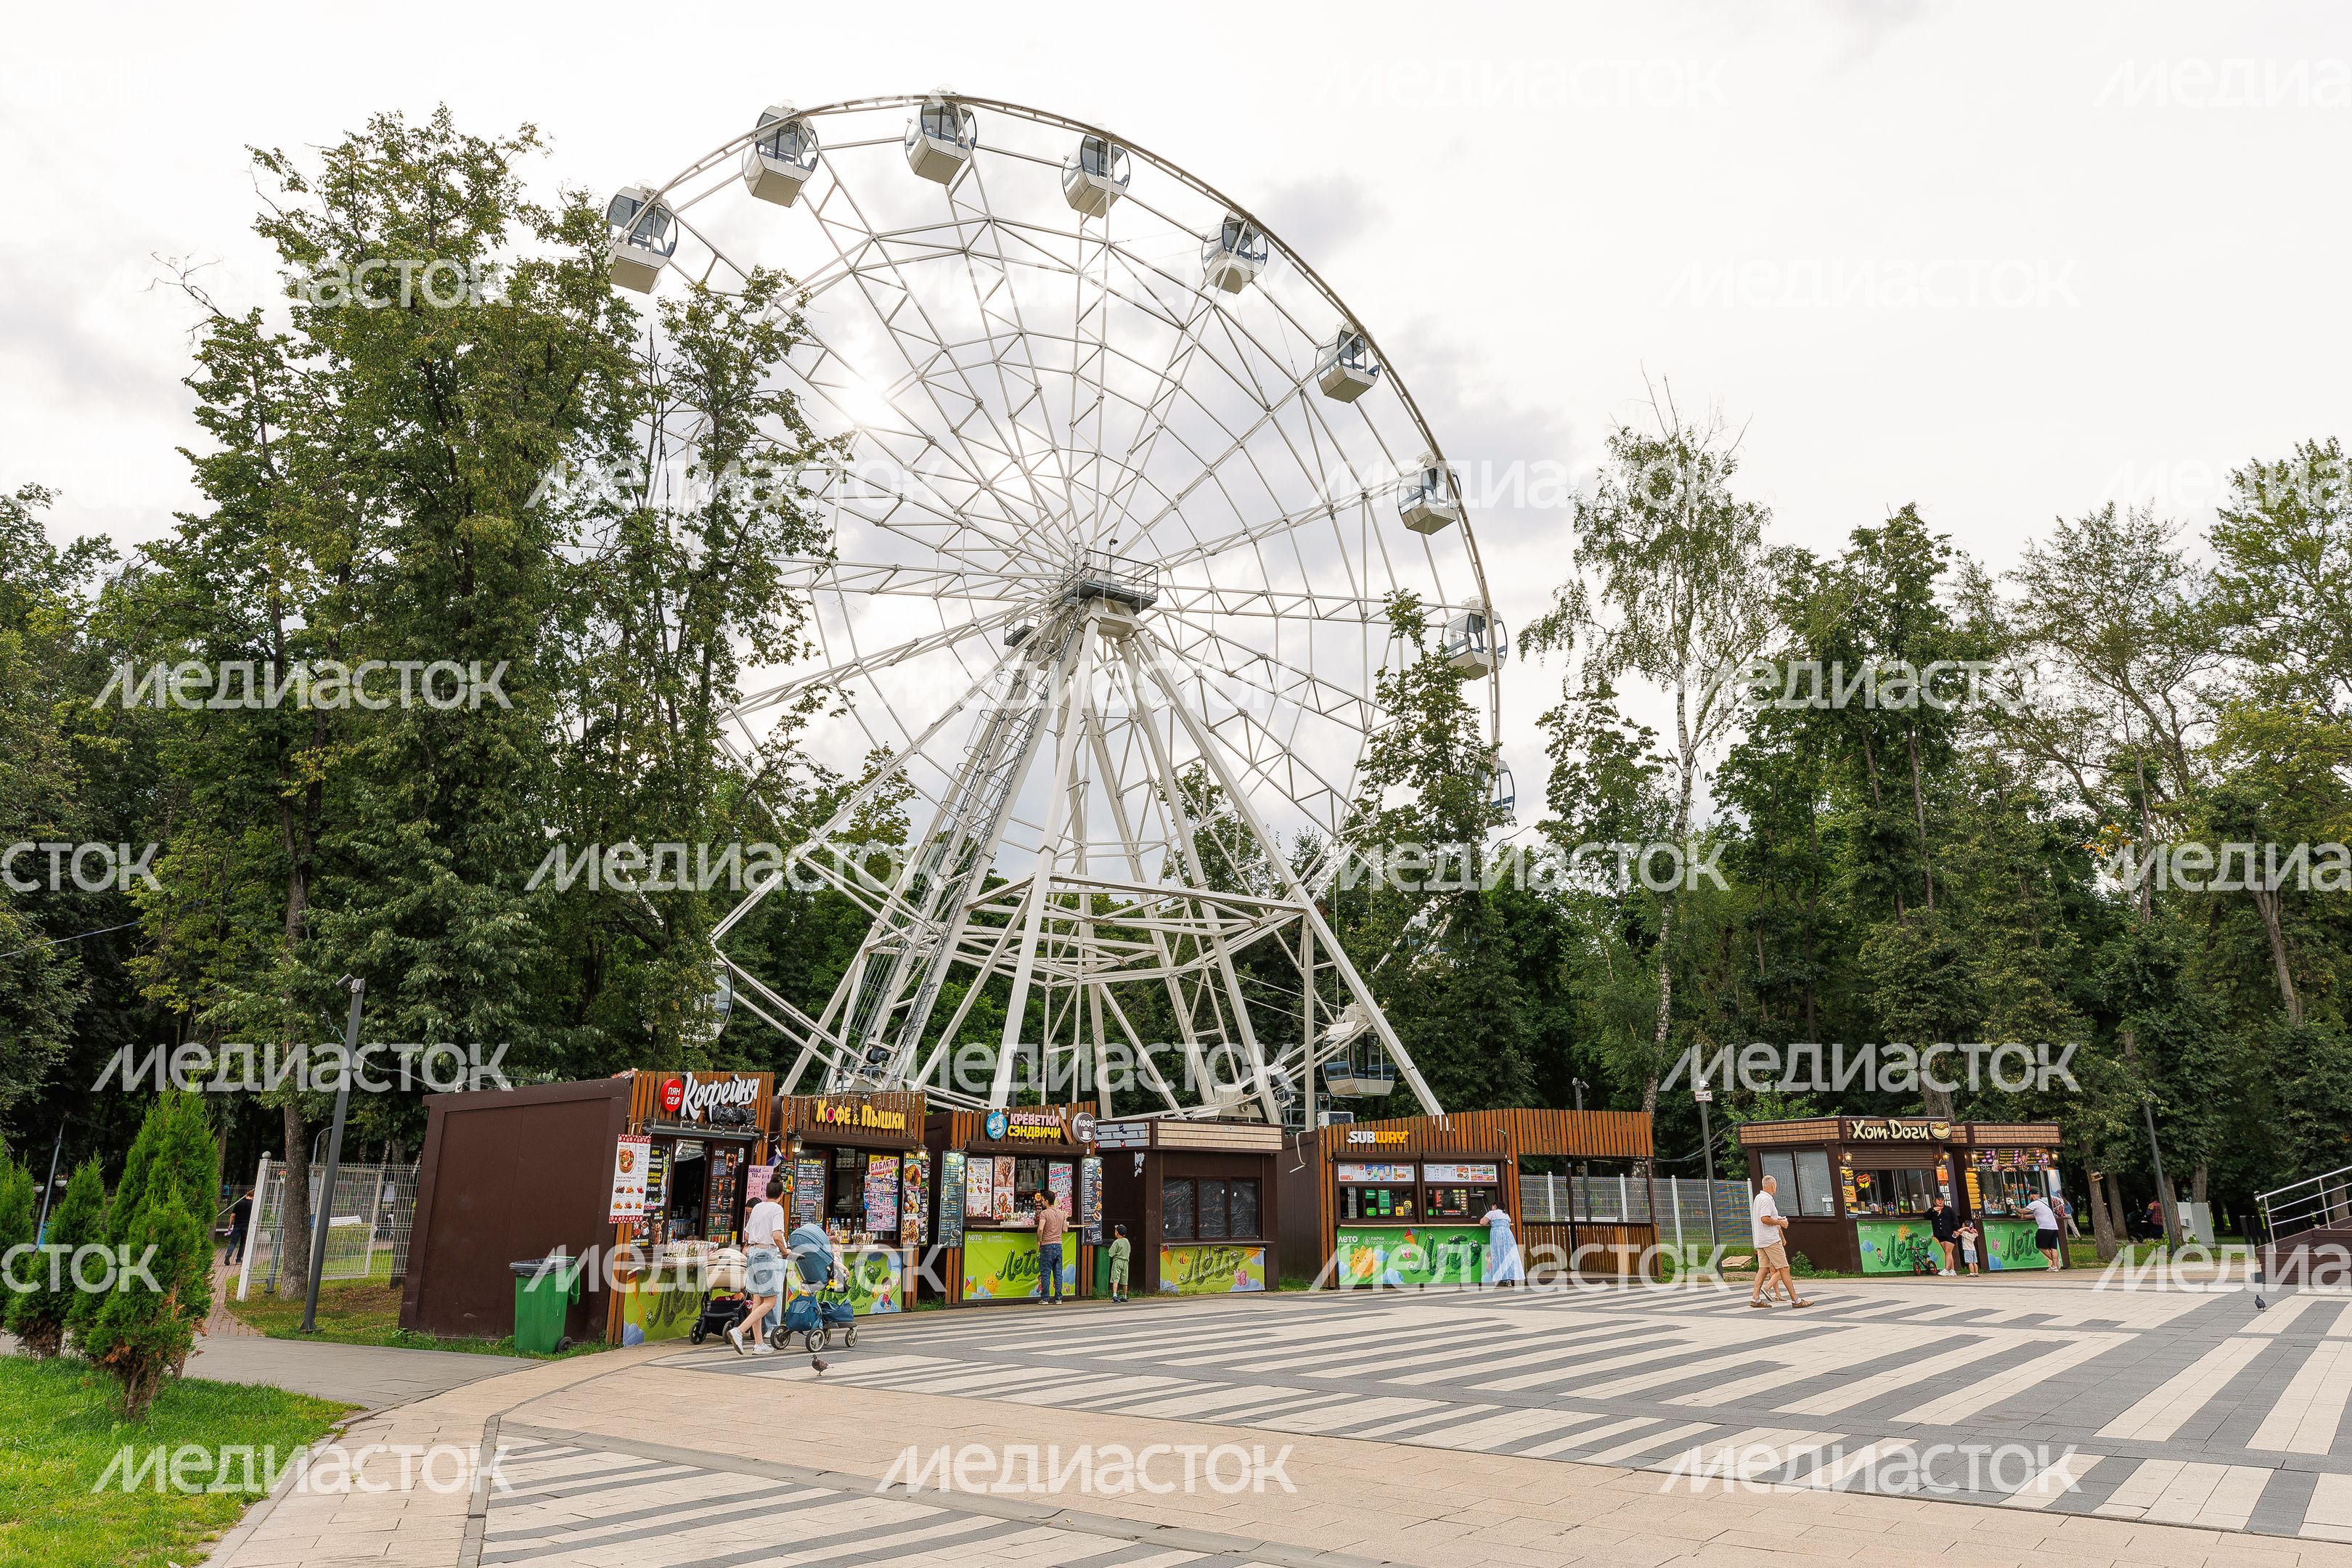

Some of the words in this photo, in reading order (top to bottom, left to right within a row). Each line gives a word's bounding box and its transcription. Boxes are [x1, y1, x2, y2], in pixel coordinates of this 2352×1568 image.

[668, 1087, 681, 1095] ПЯН
[681, 1071, 759, 1122] Кофейня
[1010, 1113, 1059, 1126] КРЕВЕТКИ
[1078, 1119, 1094, 1127] КОФЕ
[1008, 1125, 1061, 1139] СЭНДВИЧИ
[1347, 1130, 1410, 1144] SUBWAY
